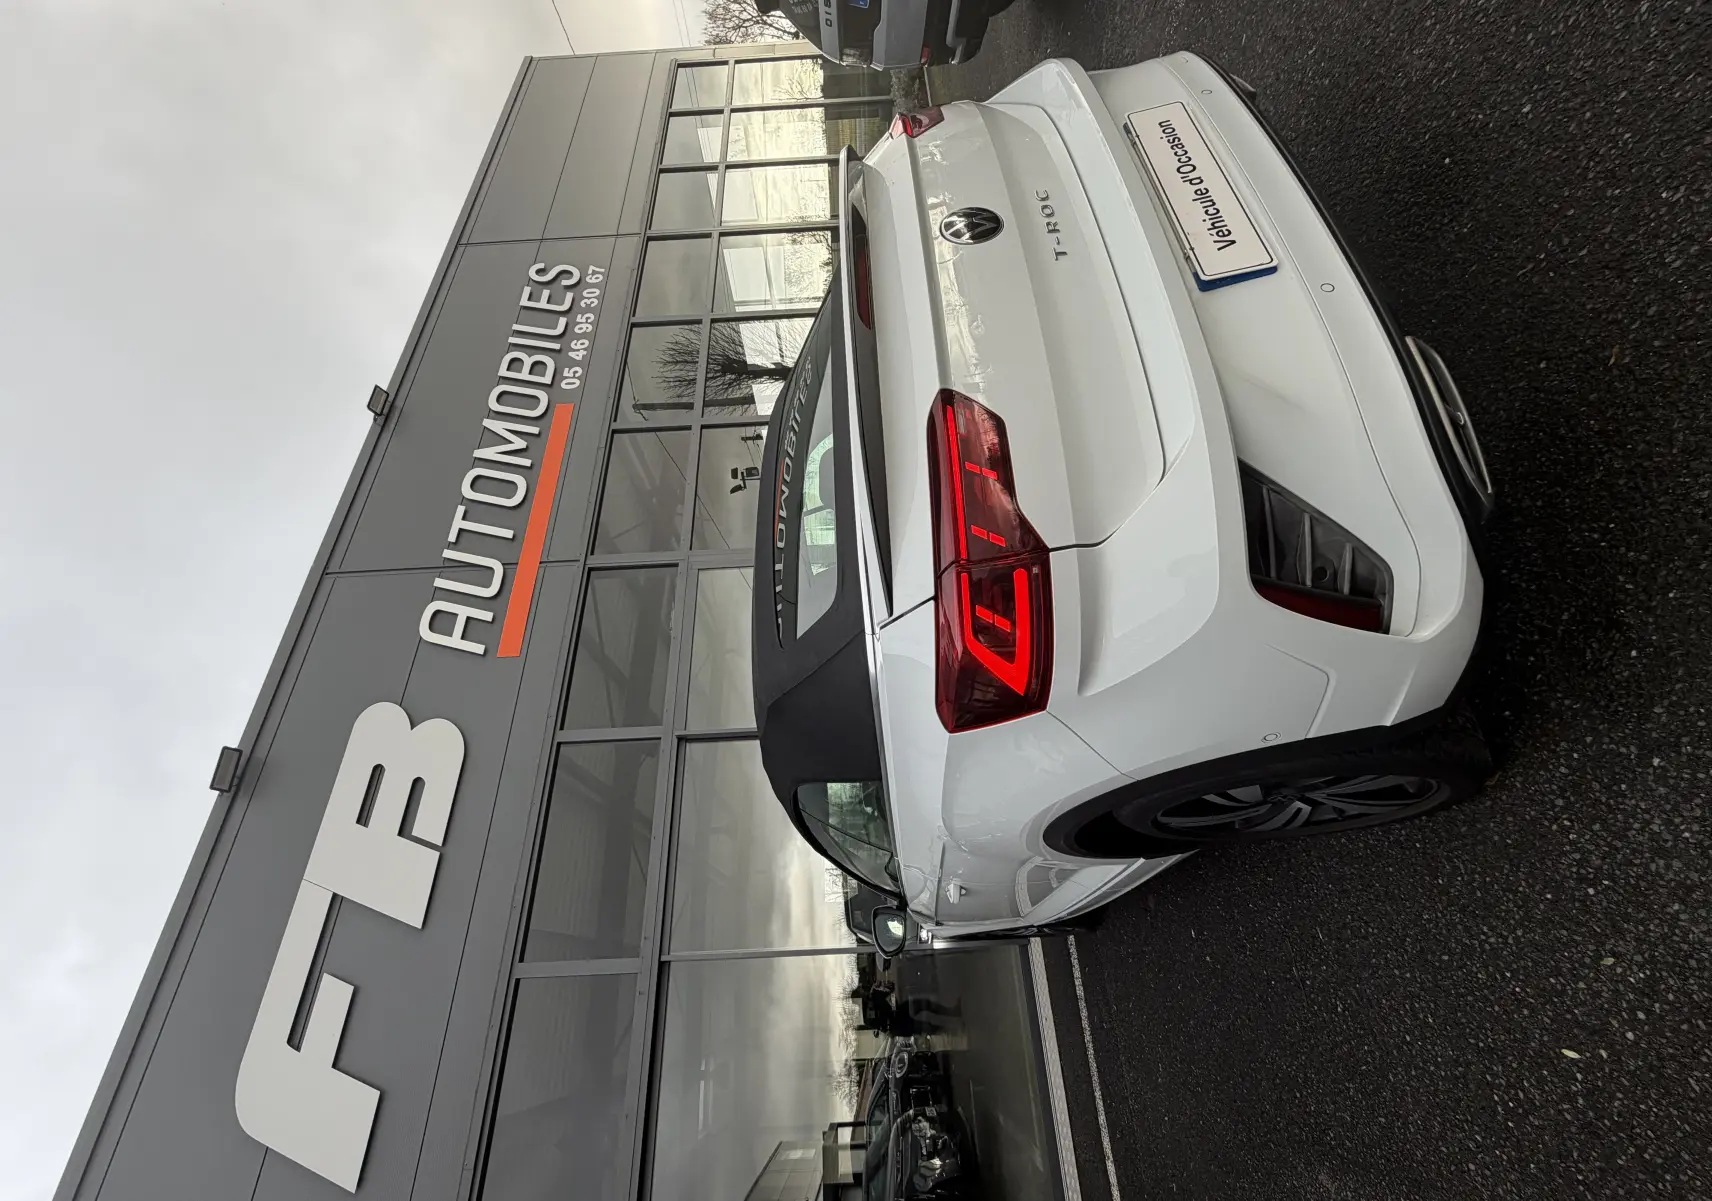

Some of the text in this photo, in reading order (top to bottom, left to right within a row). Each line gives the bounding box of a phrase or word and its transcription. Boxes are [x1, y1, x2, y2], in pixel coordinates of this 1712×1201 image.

[1034, 189, 1068, 261] T-ROC
[1157, 119, 1237, 251] Véhicule d'Occasion
[560, 264, 606, 390] 05 46 95 30 67
[418, 262, 581, 655] AUTOMOBILES
[235, 701, 465, 1194] FB
